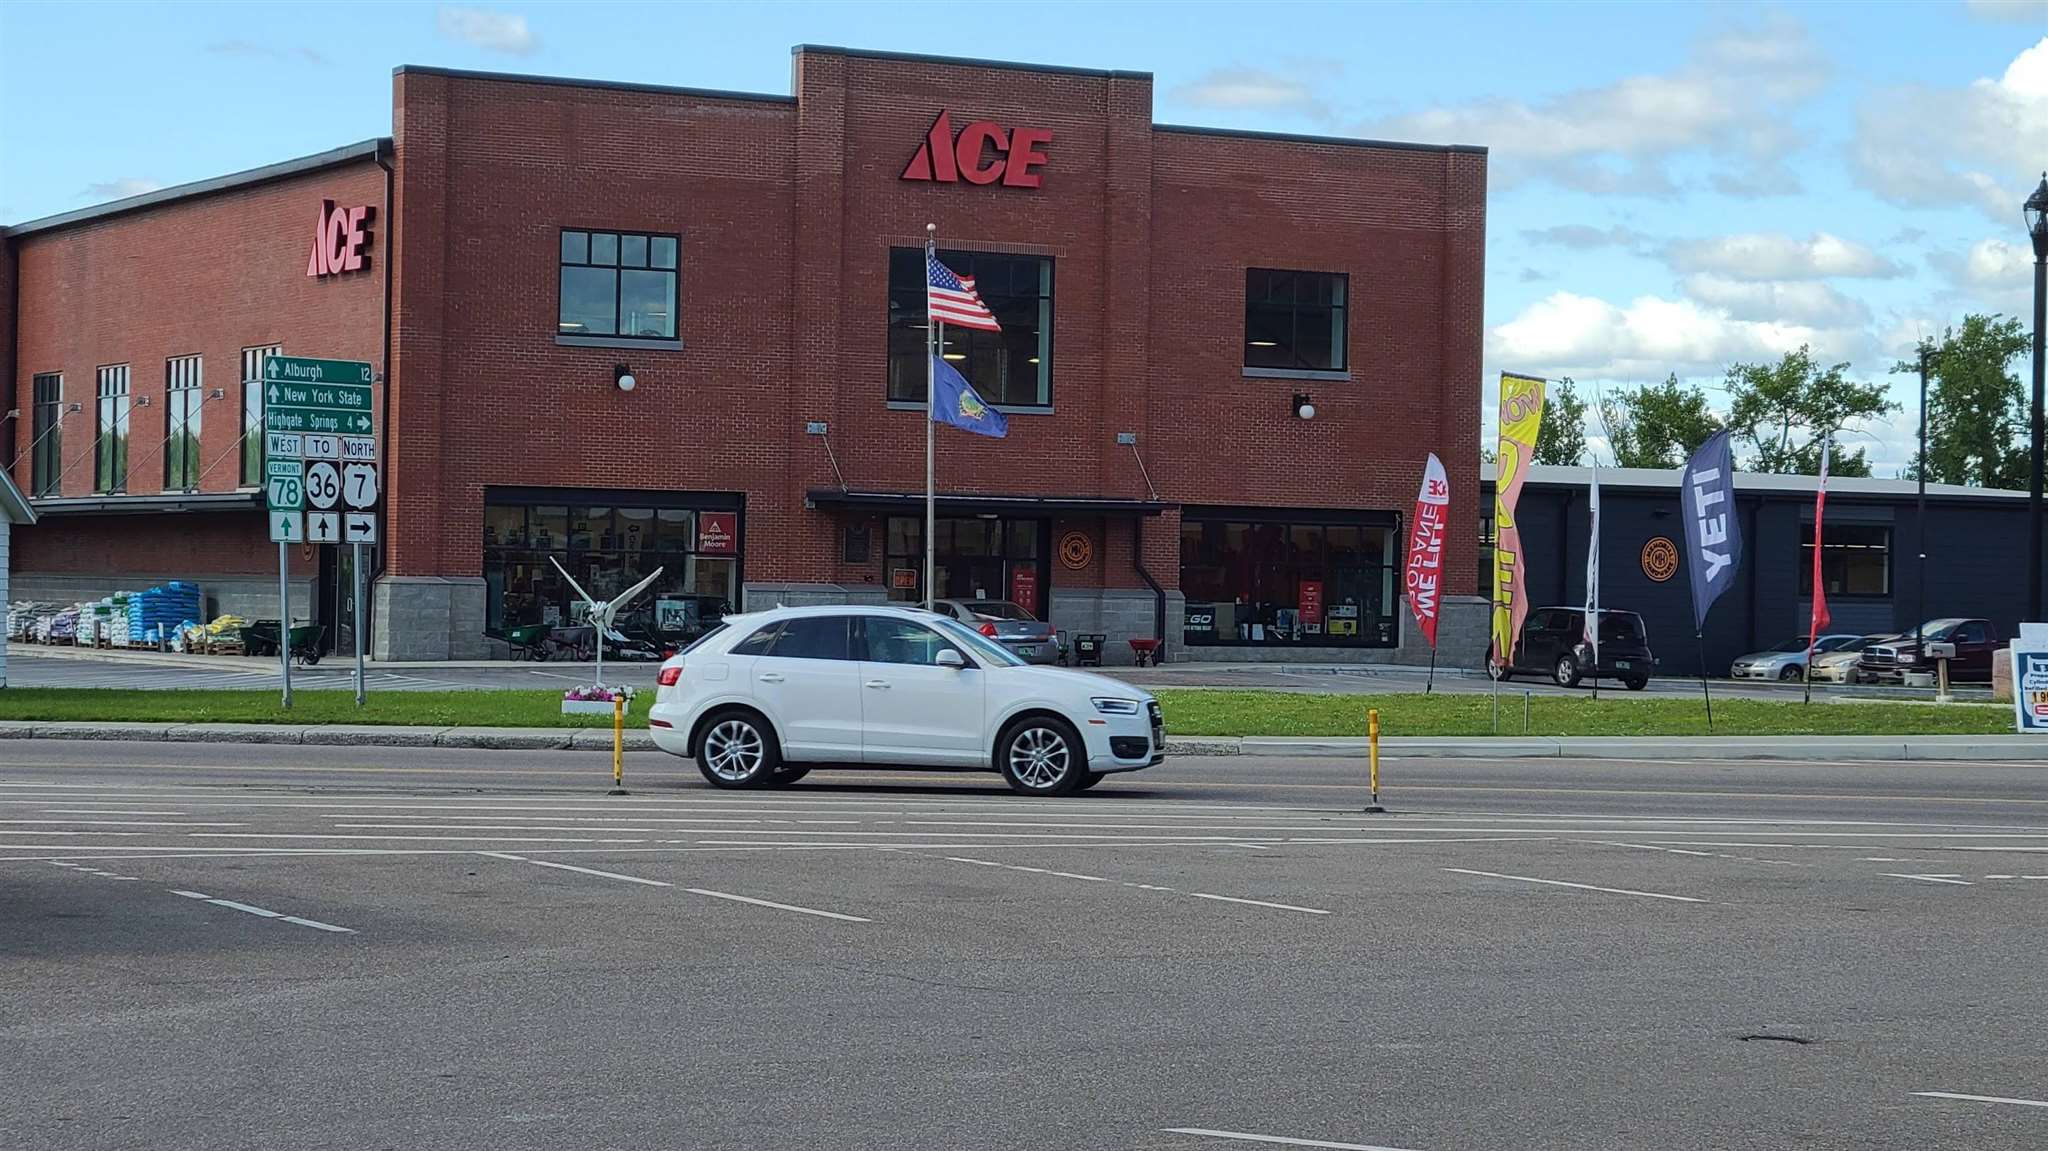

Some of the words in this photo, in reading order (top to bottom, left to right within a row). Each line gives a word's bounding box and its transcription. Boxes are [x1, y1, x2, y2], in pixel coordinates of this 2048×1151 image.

[899, 107, 1055, 189] ACE
[306, 199, 375, 277] ACE
[284, 362, 323, 381] Alburgh
[361, 368, 371, 381] 12
[284, 387, 307, 402] New
[311, 389, 334, 404] York
[338, 391, 362, 406] State
[267, 411, 303, 432] Highgate
[310, 414, 338, 433] Springs
[347, 418, 353, 430] 4
[271, 437, 298, 453] WEST
[314, 440, 330, 453] TO
[343, 442, 375, 457] NORTH
[269, 463, 300, 474] VERMONT
[273, 479, 299, 505] 78
[310, 472, 337, 499] 36
[354, 473, 367, 500] 7
[1692, 467, 1732, 583] YETI
[699, 533, 731, 541] Benjamin
